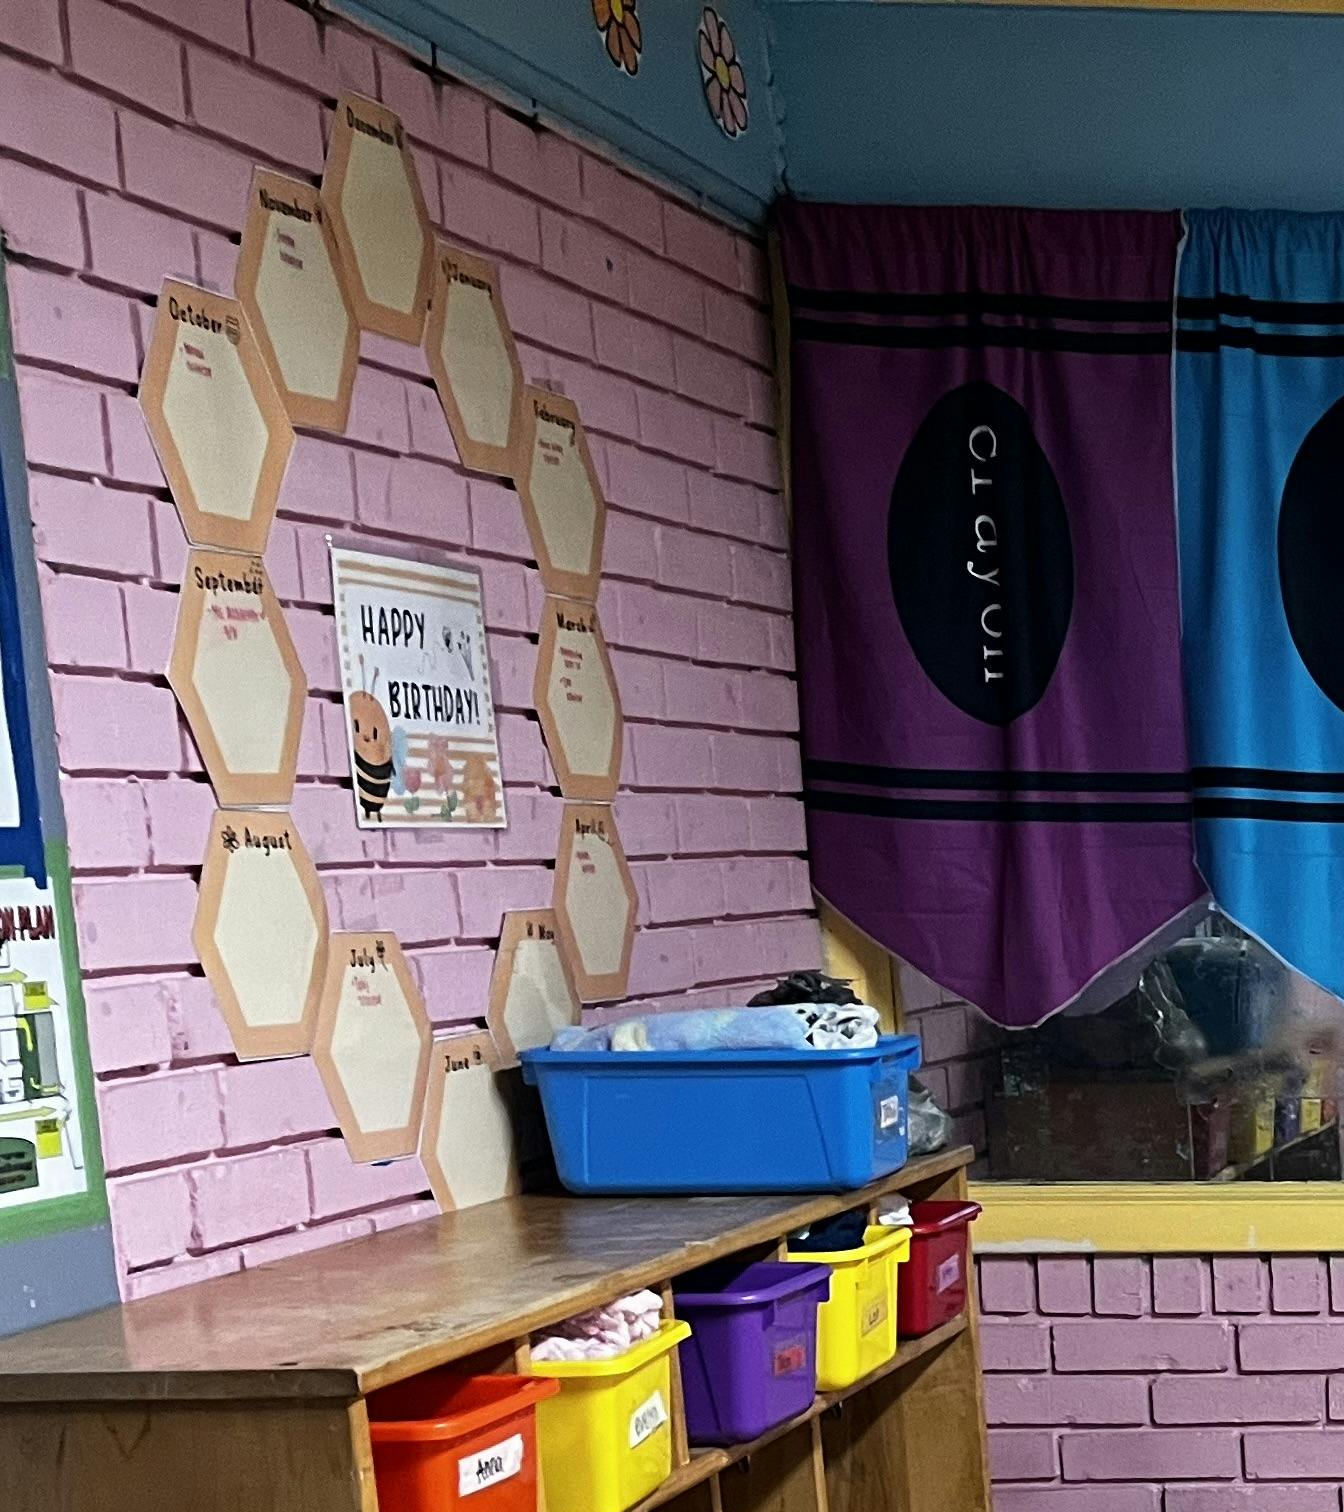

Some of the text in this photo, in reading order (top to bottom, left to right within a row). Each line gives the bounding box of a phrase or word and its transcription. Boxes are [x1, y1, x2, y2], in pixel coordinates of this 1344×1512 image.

[169, 296, 222, 334] October
[194, 566, 263, 597] September
[360, 604, 426, 649] HAPPY
[388, 681, 481, 725] BIRTHDAY!
[244, 826, 292, 857] August
[349, 947, 376, 974] July
[444, 1055, 469, 1073] June
